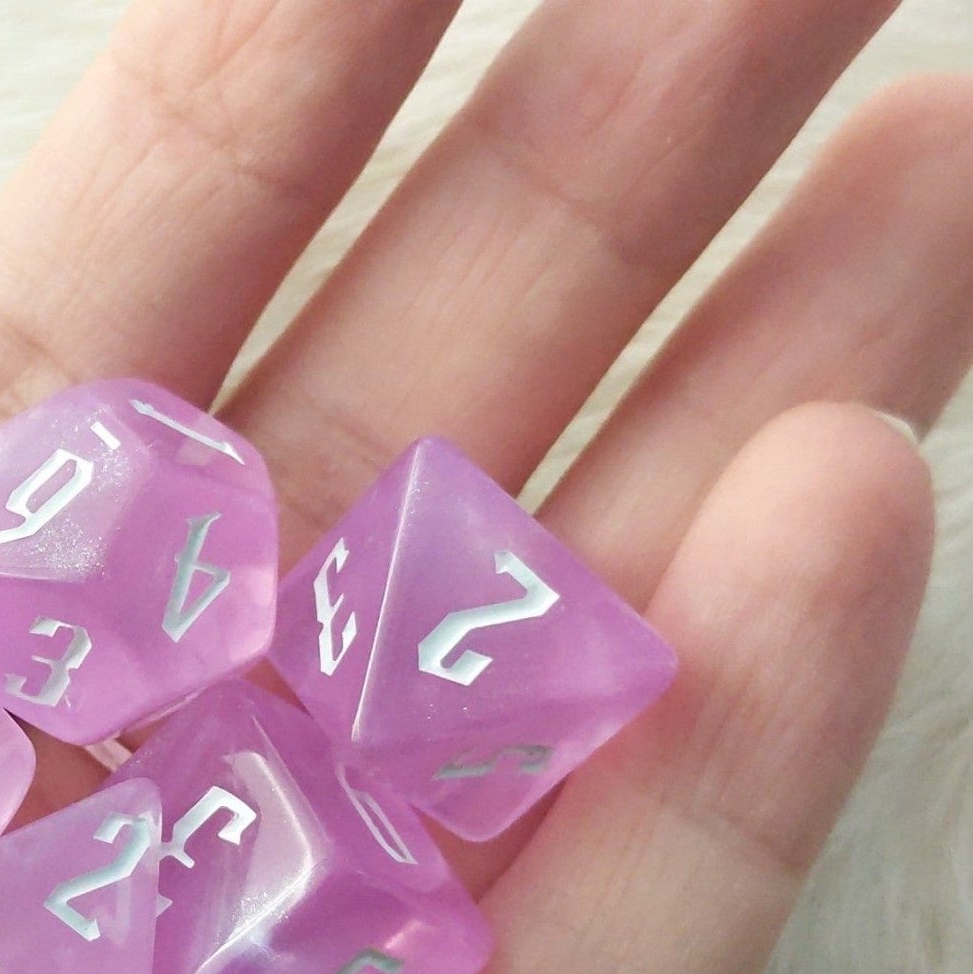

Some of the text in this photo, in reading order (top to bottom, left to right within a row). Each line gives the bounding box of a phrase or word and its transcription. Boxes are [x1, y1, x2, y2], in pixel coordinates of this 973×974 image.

[162, 511, 231, 643] 4
[313, 536, 358, 677] 3
[418, 549, 561, 686] 2
[4, 616, 93, 707] 3
[43, 811, 134, 942] 2
